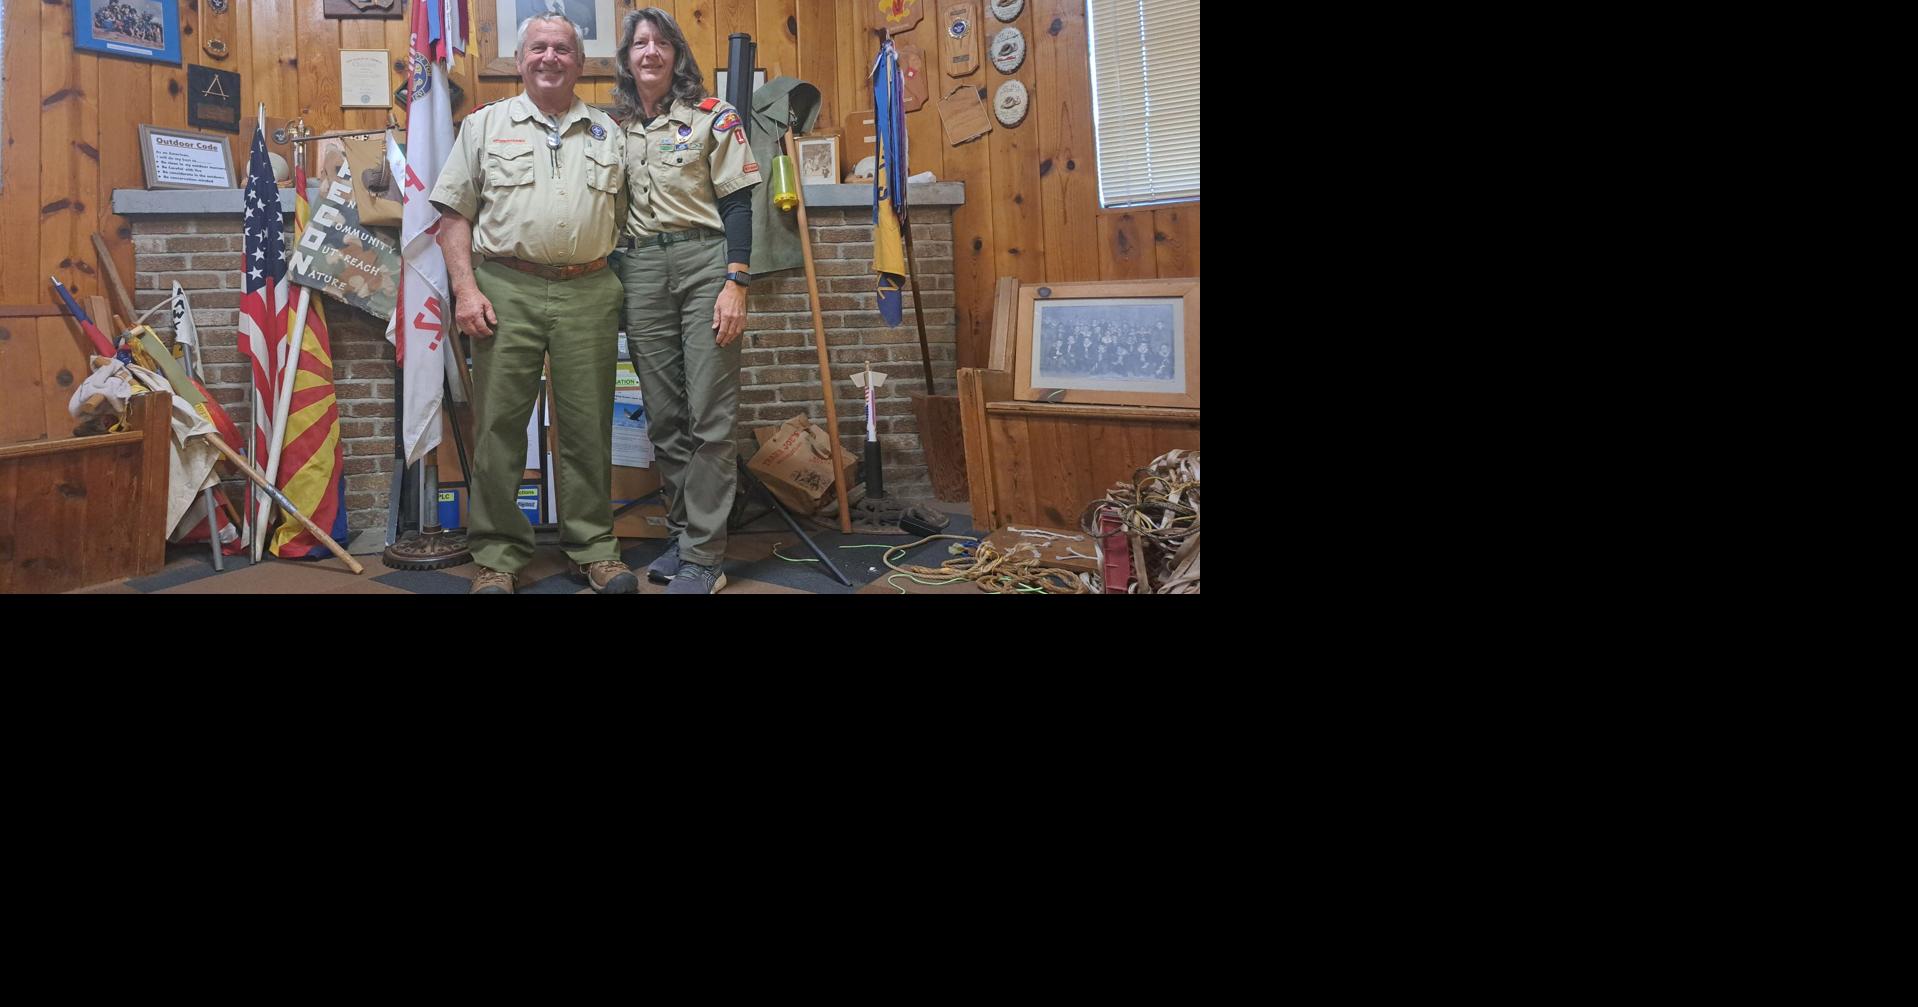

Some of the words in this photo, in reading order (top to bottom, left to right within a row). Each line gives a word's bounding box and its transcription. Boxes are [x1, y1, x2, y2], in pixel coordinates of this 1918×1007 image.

[156, 138, 193, 148] Outdoor
[197, 142, 218, 150] Code
[783, 431, 800, 450] JOE'S
